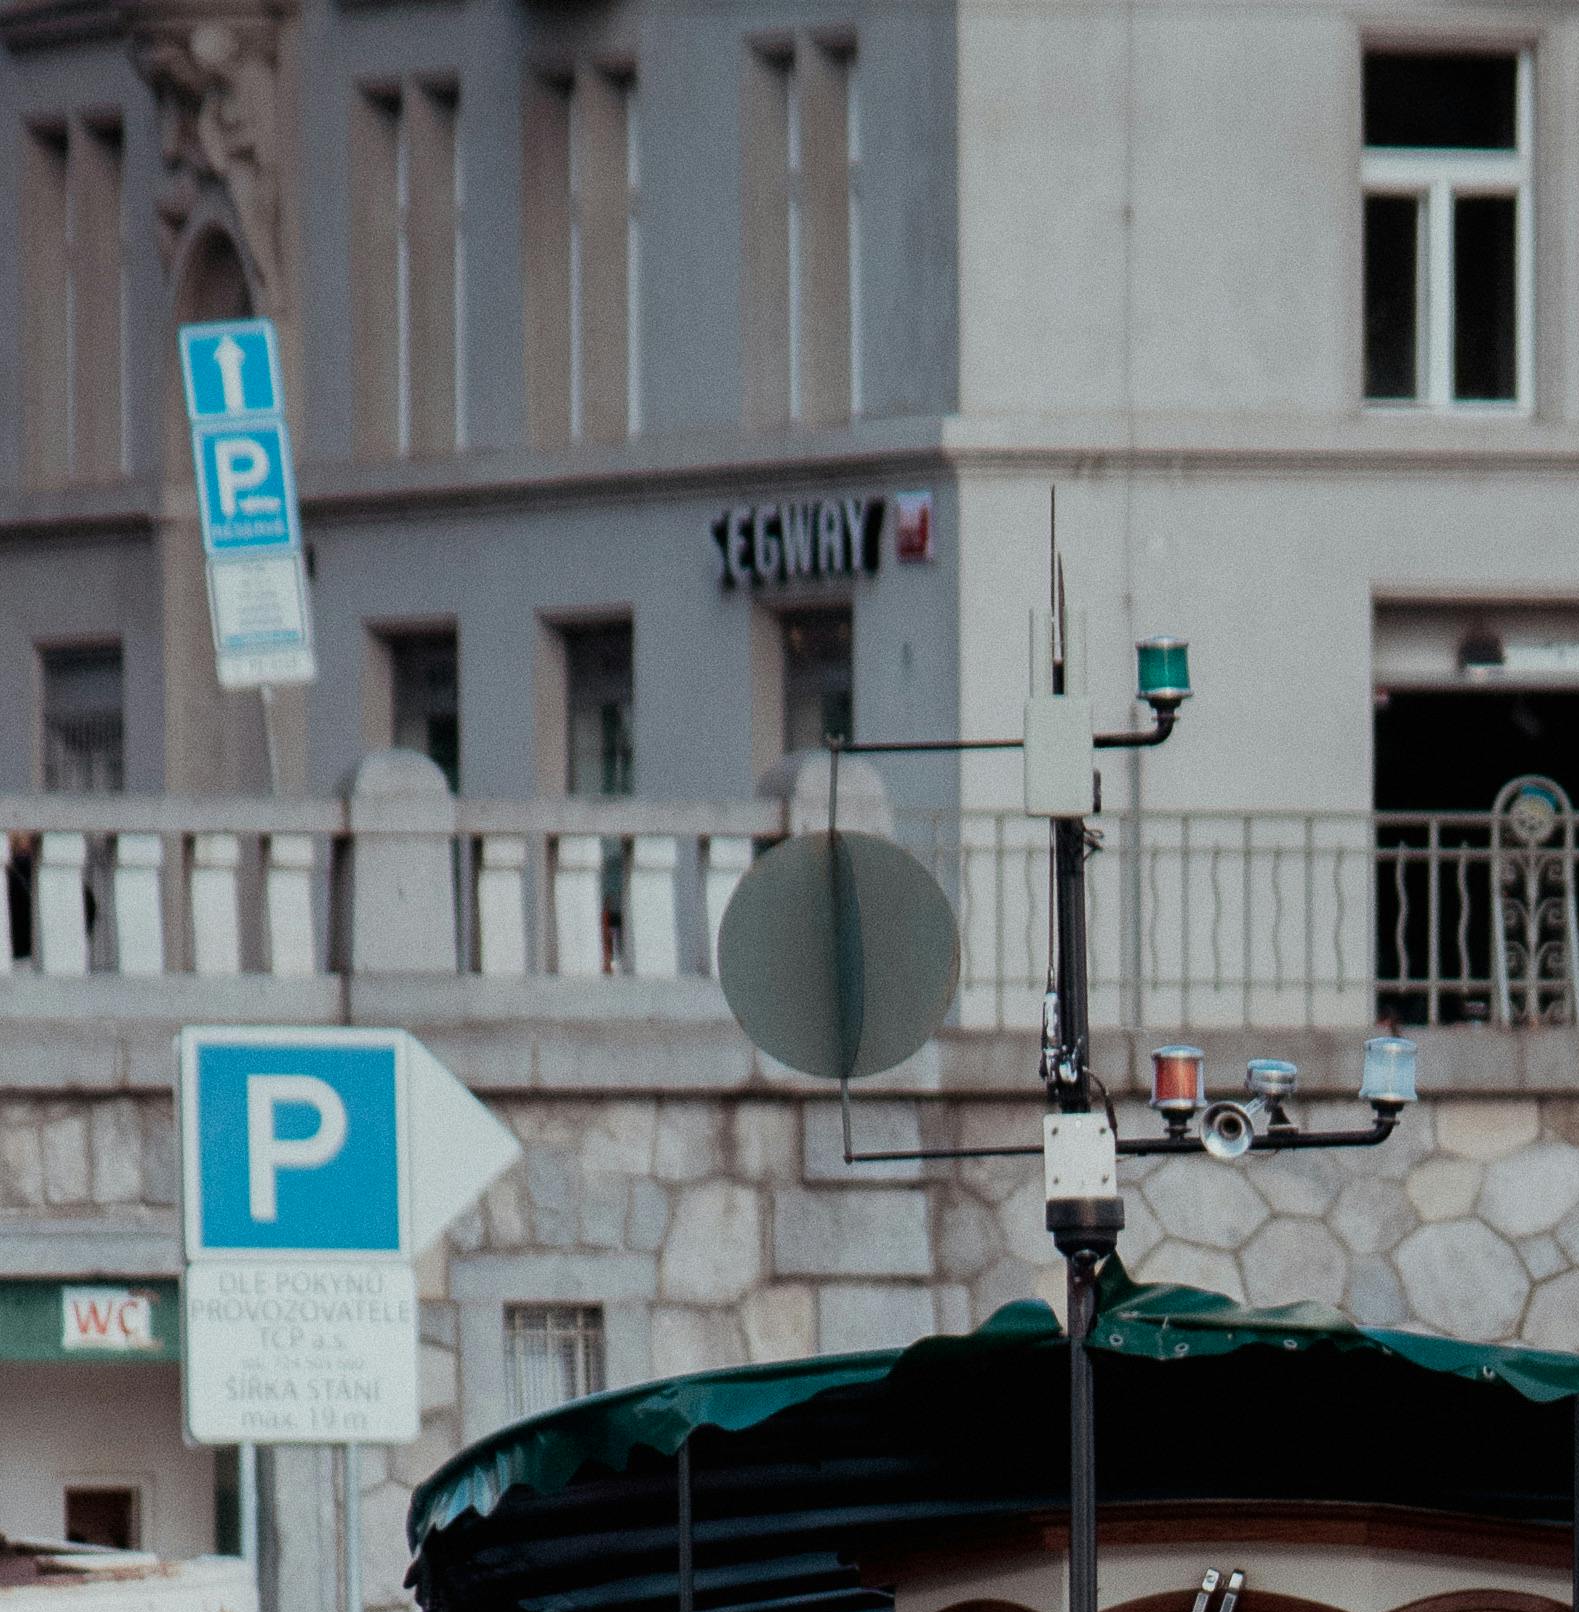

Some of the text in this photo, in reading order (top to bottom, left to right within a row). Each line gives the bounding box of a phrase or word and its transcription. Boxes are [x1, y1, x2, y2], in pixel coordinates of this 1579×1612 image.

[215, 440, 271, 519] P
[246, 1073, 348, 1223] P
[219, 1272, 267, 1296] DLE
[72, 1299, 138, 1336] WC
[191, 1298, 409, 1323] PROVOZOVATELE
